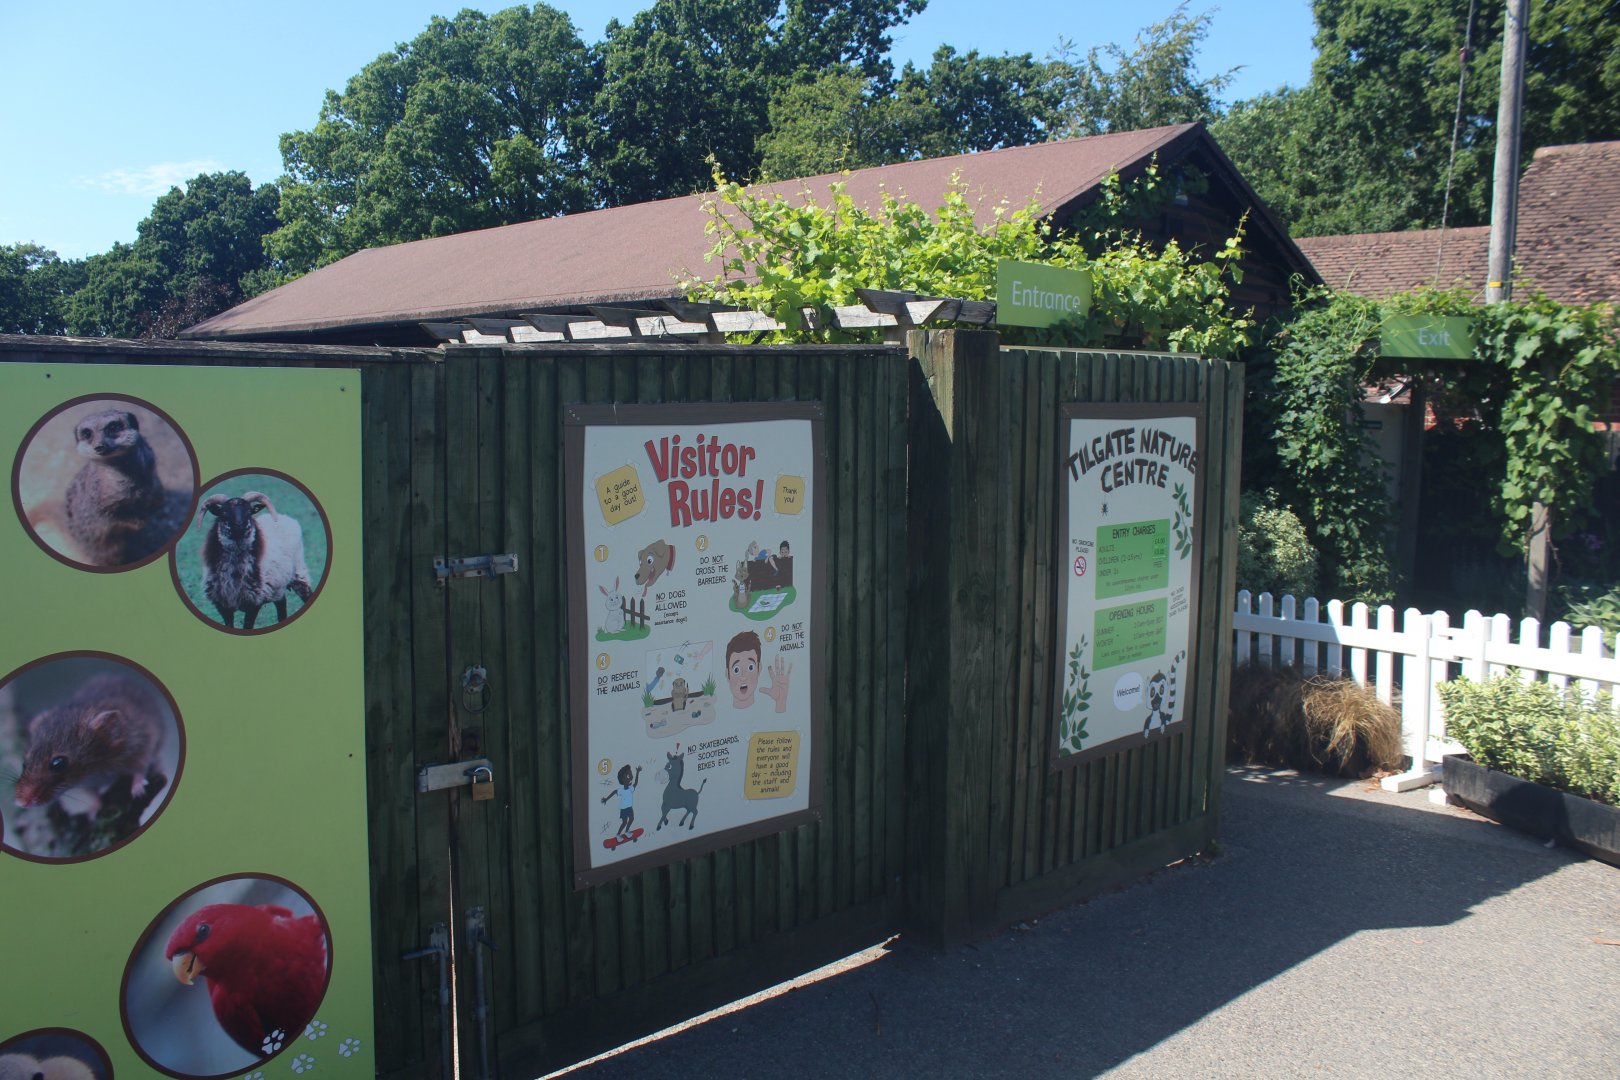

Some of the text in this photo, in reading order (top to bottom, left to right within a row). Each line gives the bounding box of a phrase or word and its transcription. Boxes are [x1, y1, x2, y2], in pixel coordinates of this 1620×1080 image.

[1011, 280, 1080, 312] Entrance
[1418, 328, 1450, 346] Exit
[643, 433, 756, 483] Visitor
[1063, 427, 1200, 482] TILGATE NATURE
[1100, 458, 1169, 493] CENTRE
[606, 479, 630, 495] A guide
[782, 486, 798, 495] Thank
[604, 497, 612, 505] to
[622, 484, 638, 500] good
[610, 503, 621, 513] day
[668, 479, 764, 528] Rules!
[1112, 524, 1156, 539] ENTRY CHARGES
[699, 554, 725, 565] DO NOT
[695, 564, 729, 576] CROSS THE
[697, 575, 727, 587] BARRIERS
[655, 590, 686, 601] NO DOGS
[654, 600, 687, 612] ALLOWED
[1109, 603, 1154, 621] OPENING HOURS
[781, 622, 803, 632] DO NOT
[780, 631, 804, 642] FEED THE
[779, 641, 805, 652] ANIMALS
[597, 670, 639, 685] DO RESPECT
[596, 680, 641, 695] THE ANIMALS
[1116, 684, 1141, 697] Welcome!
[687, 735, 740, 754] NO SKATEBOARDS,
[757, 737, 774, 745] Please
[697, 760, 716, 771] BIKES
[776, 761, 789, 770] good
[752, 770, 761, 779] day
[770, 769, 792, 777] including
[764, 777, 778, 785] staff
[780, 775, 790, 784] and
